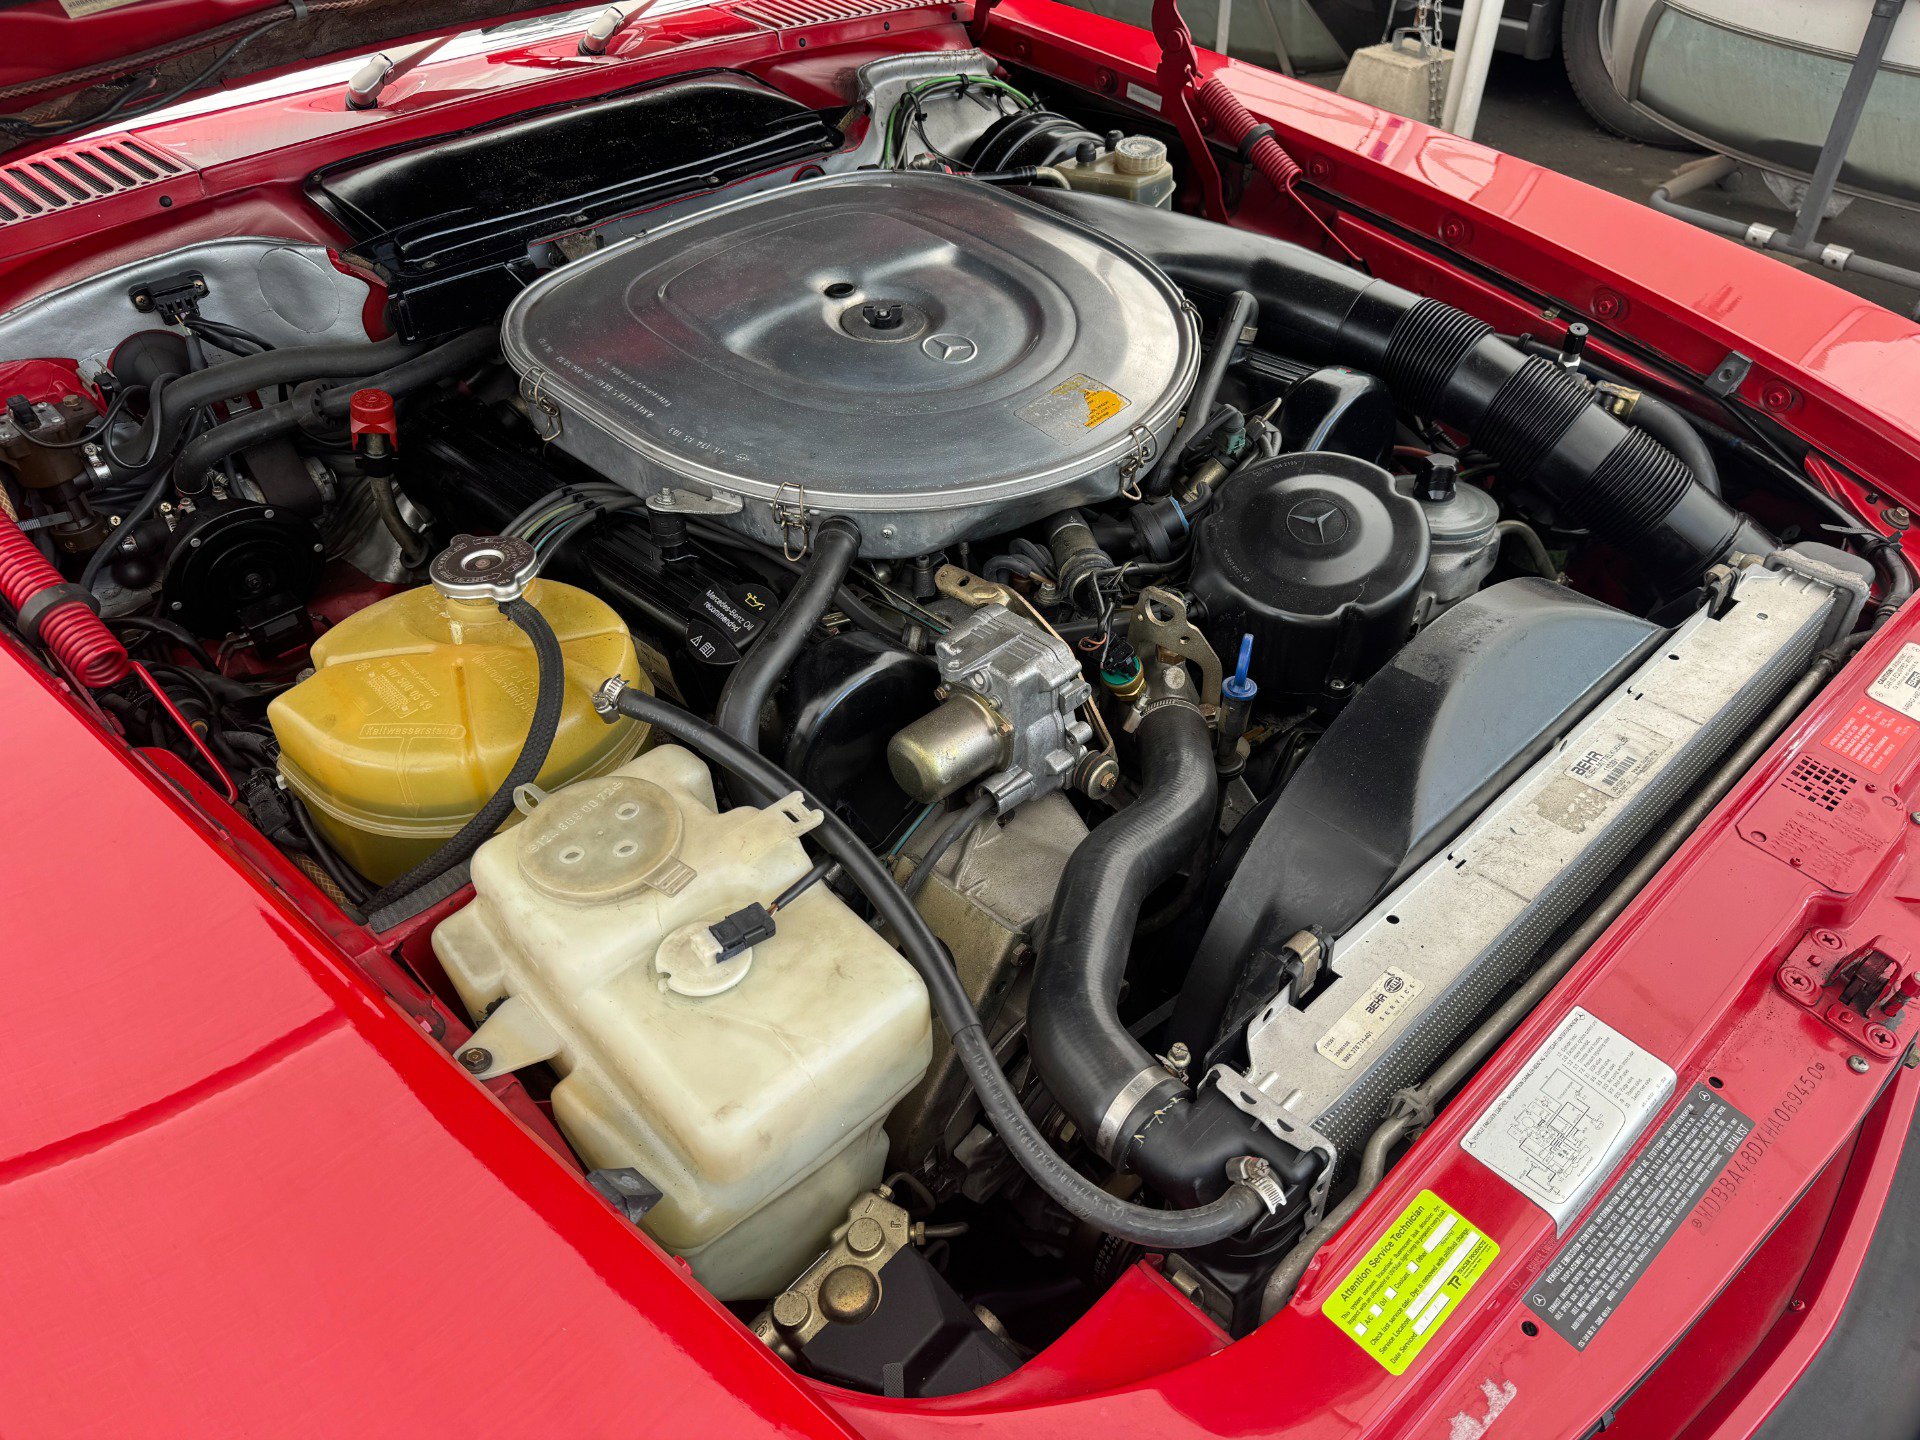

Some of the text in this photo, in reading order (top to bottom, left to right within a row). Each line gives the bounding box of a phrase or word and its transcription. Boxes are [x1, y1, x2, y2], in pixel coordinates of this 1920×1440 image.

[704, 602, 741, 632] recommended
[706, 590, 754, 631] Mercedes-Benz Oil
[366, 726, 458, 736] Kaltwasserstand
[1569, 749, 1604, 776] BEHR
[1365, 992, 1387, 1014] BEHR
[1723, 1122, 1749, 1153] CATALYST
[1544, 1262, 1564, 1285] VEHICLE
[1560, 1241, 1582, 1266] EMISSION
[1578, 1221, 1598, 1244] CONTROL
[1594, 1194, 1620, 1225] INFORMATION
[1616, 1165, 1644, 1197] DAIMLER-BENZ
[1559, 1250, 1588, 1283] DISPLACEMENT:
[1616, 1197, 1630, 1213] ENGINE
[1339, 1204, 1424, 1302] Attention Service Technician
[1340, 1309, 1351, 1320] This
[1349, 1295, 1364, 1311] system
[1361, 1278, 1378, 1296] contains
[1393, 1237, 1412, 1259] fluorescent
[1410, 1228, 1420, 1239] leak
[1418, 1211, 1434, 1230] detection
[1456, 1258, 1471, 1274] TRACER
[1468, 1239, 1486, 1260] PRODUCTS
[1346, 1309, 1361, 1325] Inspect
[1358, 1301, 1368, 1311] with
[1399, 1251, 1410, 1262] light
[1363, 1249, 1428, 1325] A/C Oil Coolant Other
[1369, 1330, 1384, 1346] Check
[1380, 1321, 1391, 1333] last
[1387, 1306, 1404, 1325] service
[1400, 1296, 1412, 1309] date.
[1409, 1286, 1420, 1298] Dye
[1420, 1264, 1439, 1285] removed
[1434, 1255, 1446, 1267] with
[1454, 1225, 1470, 1243] change.
[1378, 1316, 1411, 1354] Service Location
[1389, 1331, 1417, 1364] Date Serviced
